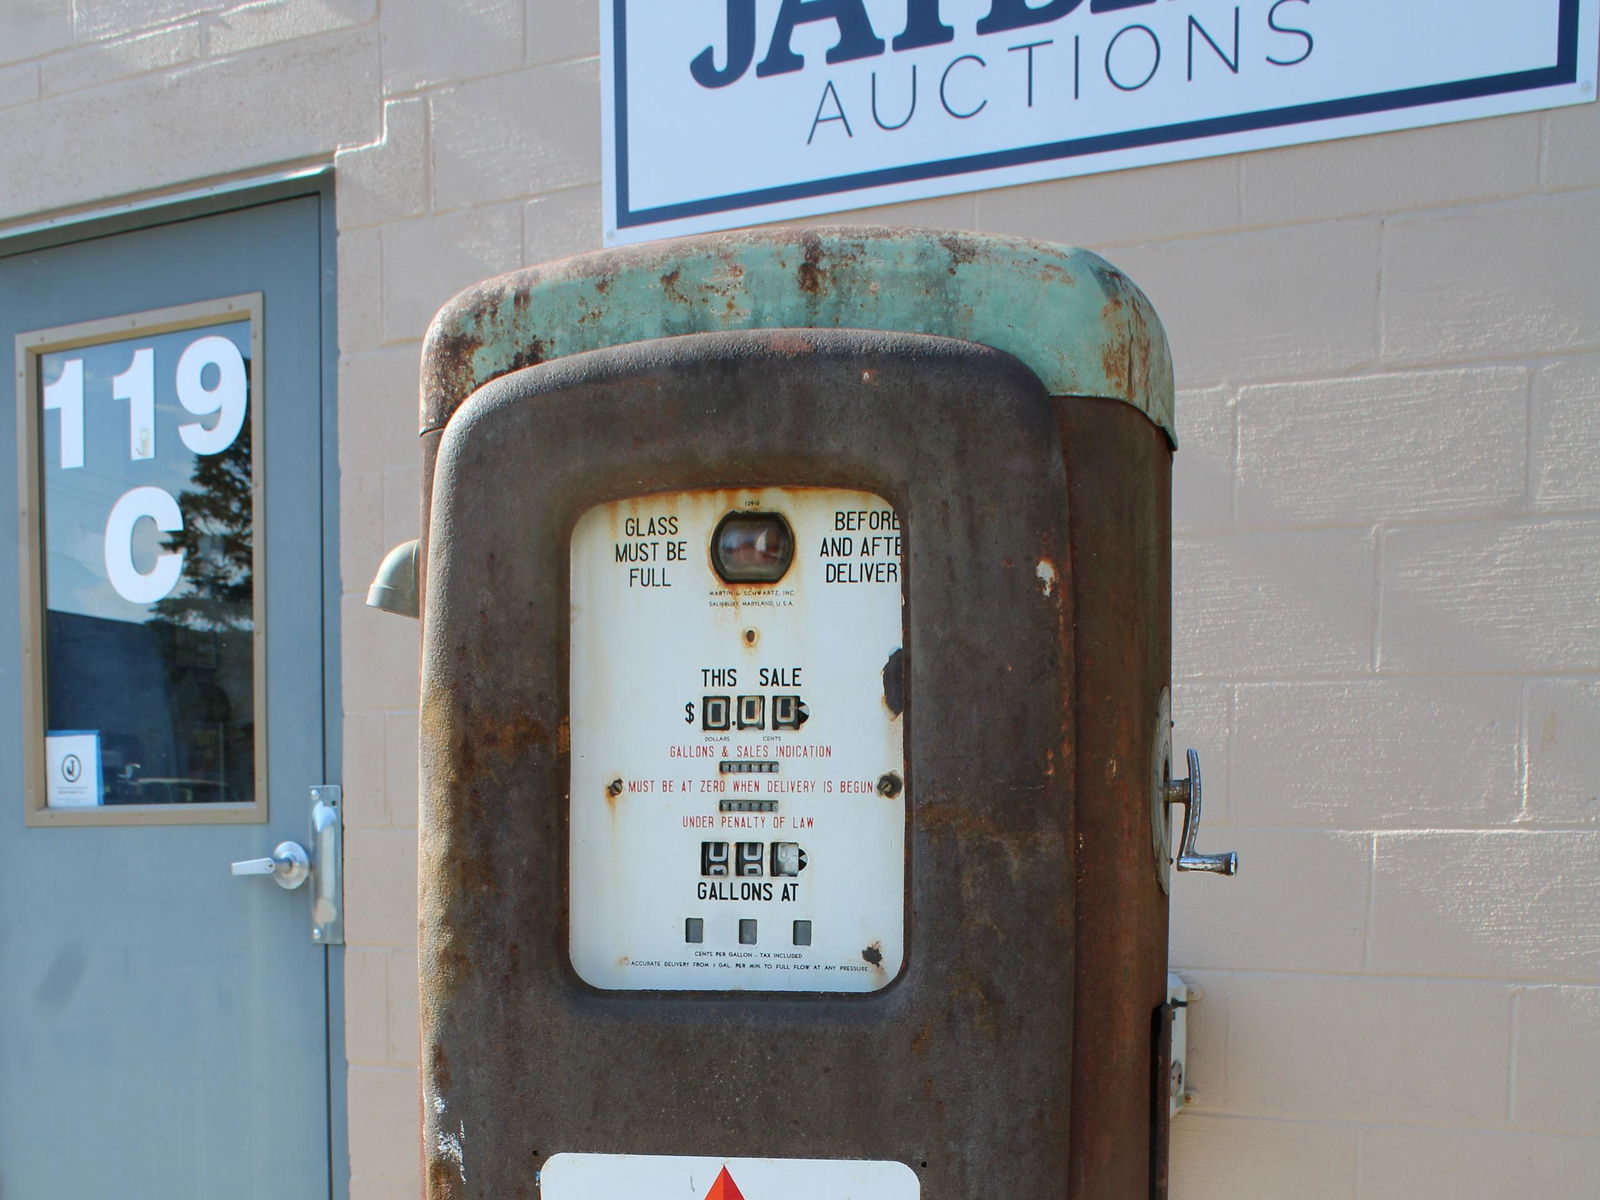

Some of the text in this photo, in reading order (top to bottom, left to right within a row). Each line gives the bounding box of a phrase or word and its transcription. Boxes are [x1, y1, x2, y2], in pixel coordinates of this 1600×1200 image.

[806, 0, 1315, 146] AUCTIONS
[44, 335, 247, 469] 119
[625, 516, 679, 537] GLASS
[104, 486, 184, 604] C
[615, 541, 688, 563] MUST BE
[820, 536, 901, 557] AND AFTE
[629, 568, 672, 588] FULL
[826, 562, 901, 583] DELIVER
[701, 667, 802, 687] THIS SALE
[669, 745, 832, 758] GALLONS & SALES INDICATION
[628, 780, 873, 793] MUST BE AT ZERO WHEN DELIVERY IS BEGUN
[682, 816, 814, 829] UNDER PENALTY OF LAW
[697, 882, 799, 902] GALLONS AT
